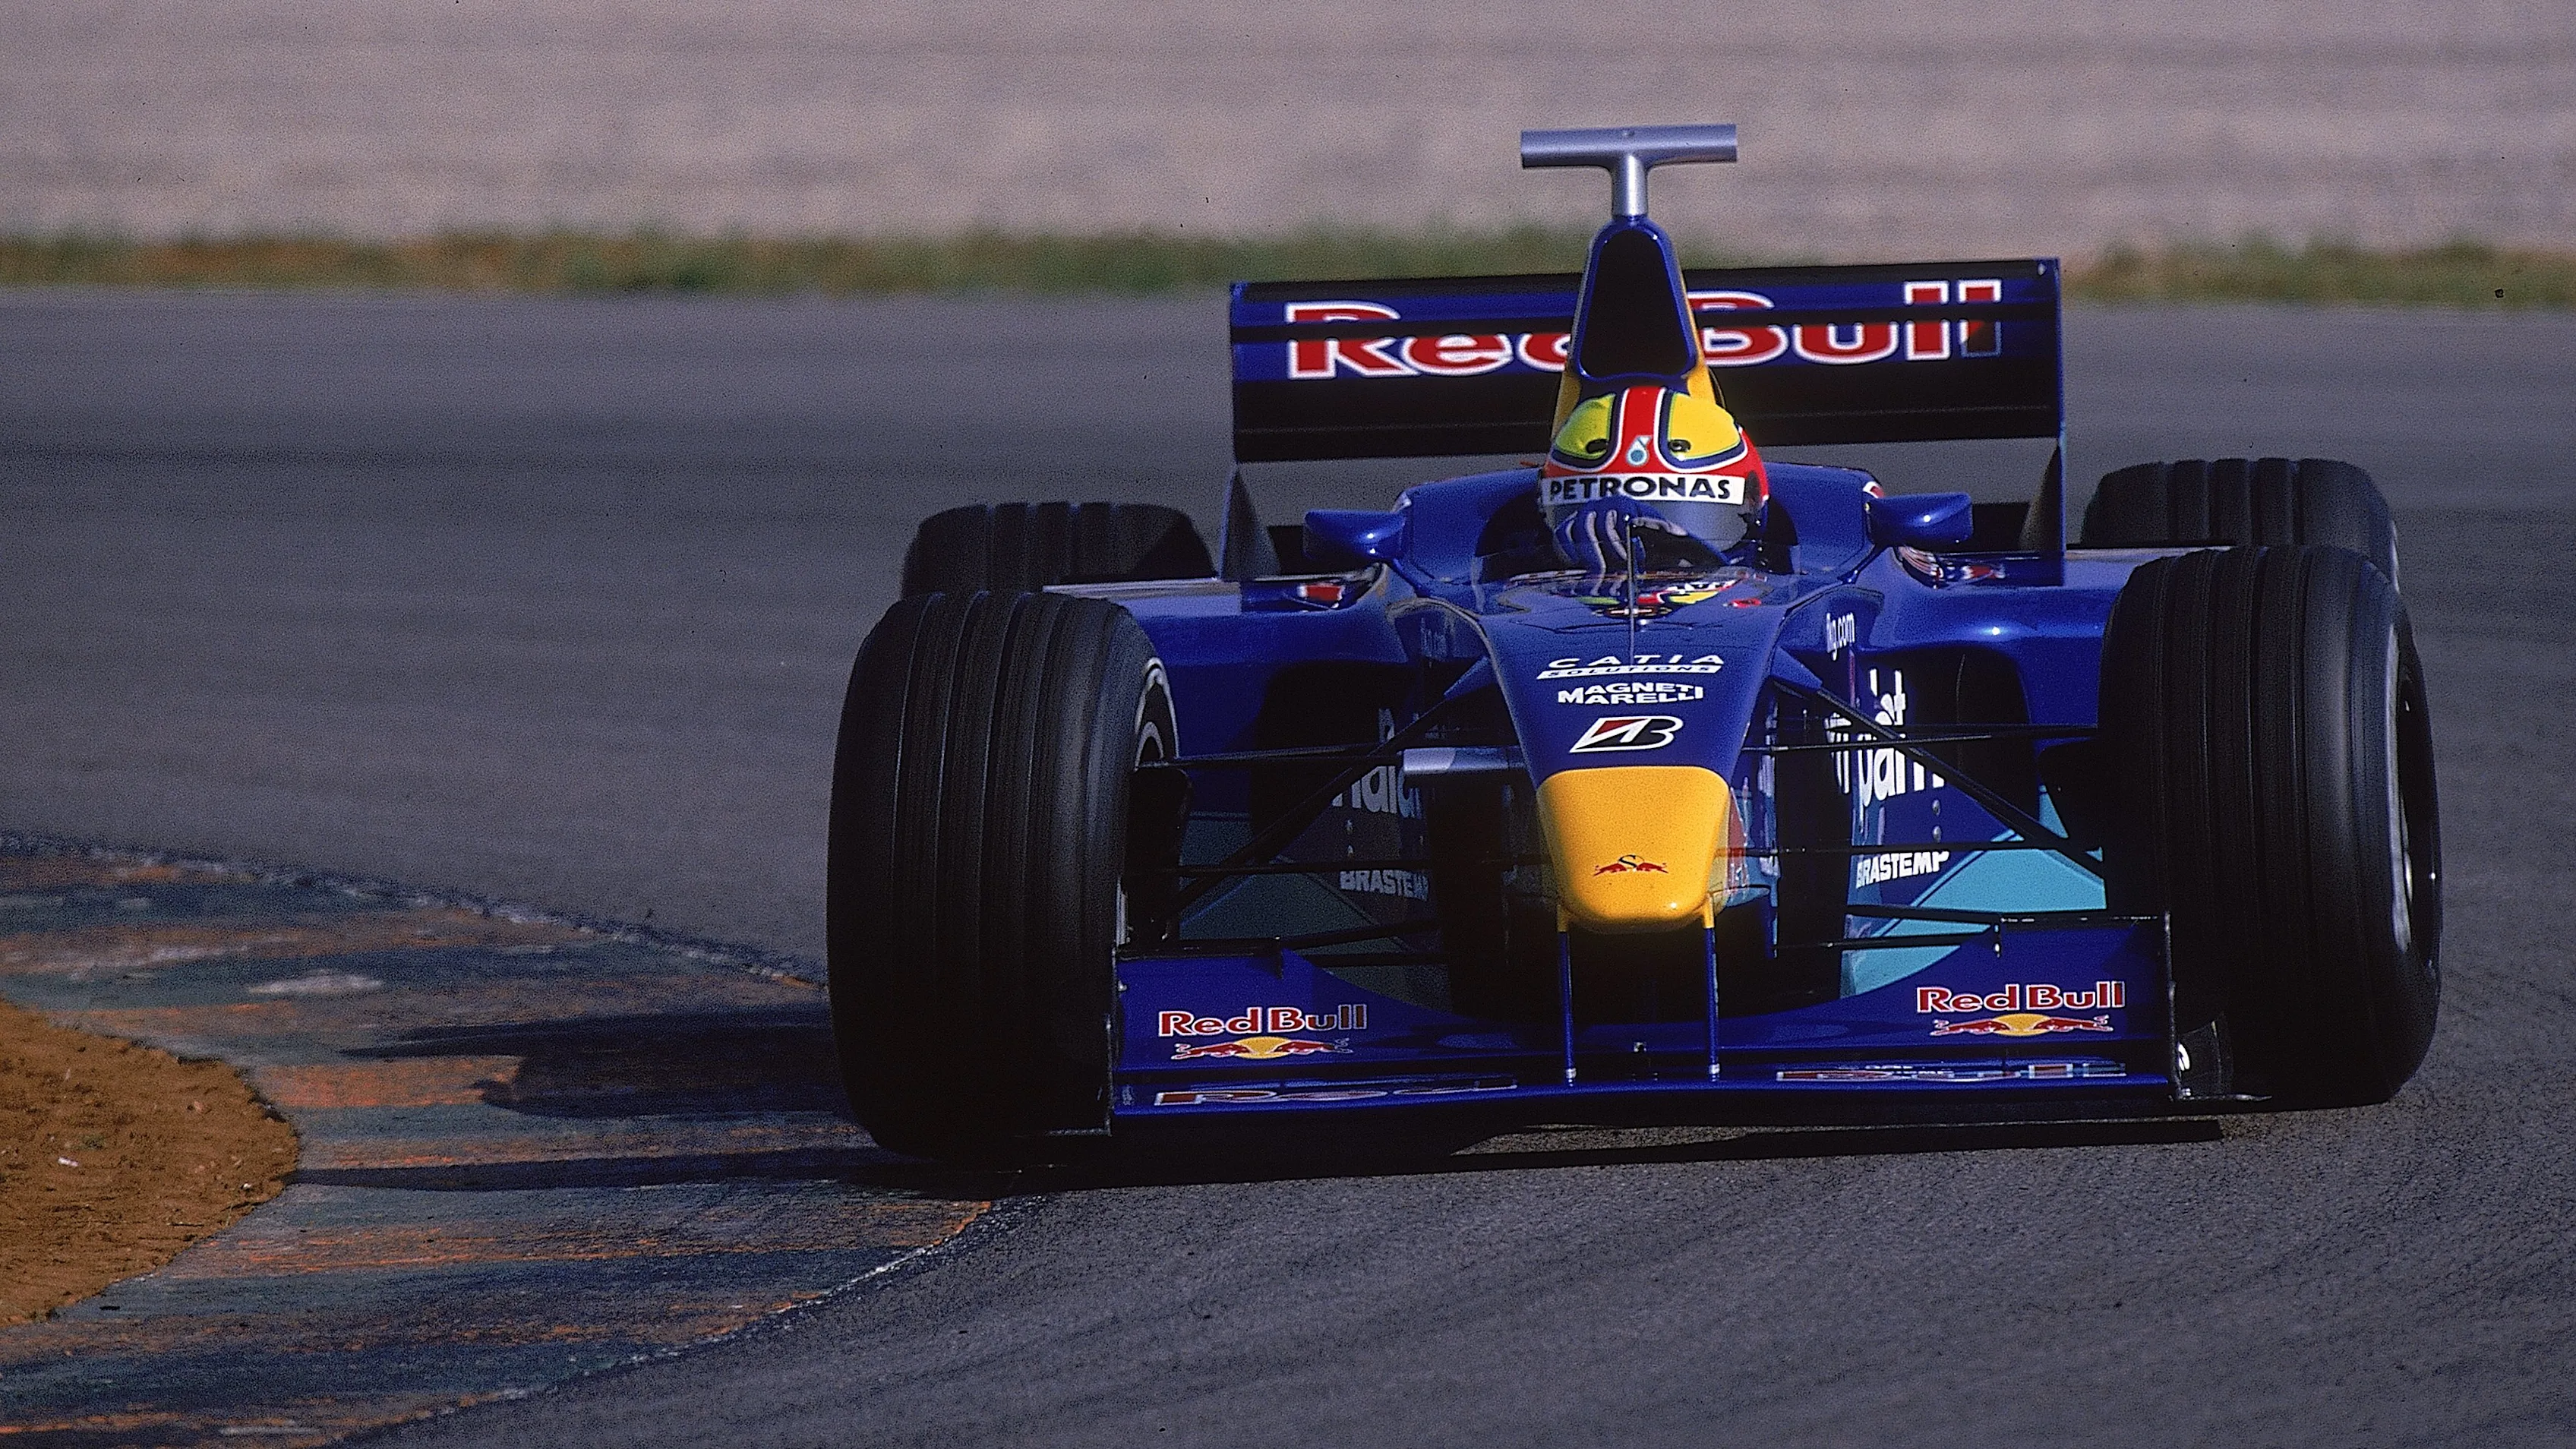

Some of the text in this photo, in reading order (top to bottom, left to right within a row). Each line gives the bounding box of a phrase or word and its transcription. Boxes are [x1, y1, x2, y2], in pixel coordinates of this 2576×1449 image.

[1549, 475, 1732, 501] PETRONAS
[1546, 665, 1710, 677] SOLUTIONS
[1548, 654, 1725, 669] CATIA
[1916, 981, 2125, 1013] Red Bull
[1158, 1004, 1368, 1036] Red Bull
